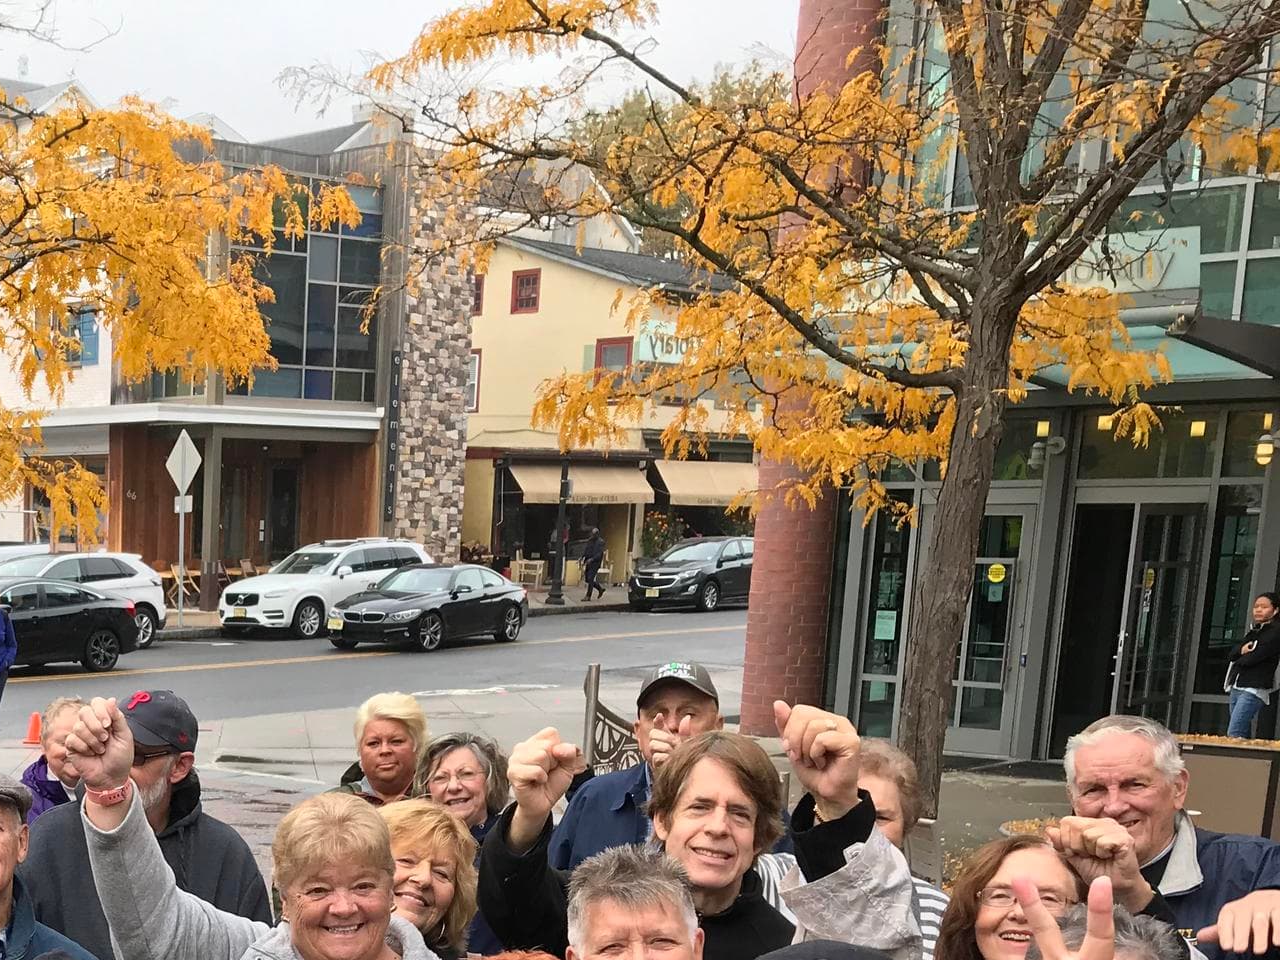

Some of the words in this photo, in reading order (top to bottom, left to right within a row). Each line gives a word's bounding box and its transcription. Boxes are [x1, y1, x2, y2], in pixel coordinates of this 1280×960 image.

[387, 356, 401, 514] elements
[126, 489, 137, 500] 66
[127, 690, 152, 710] P
